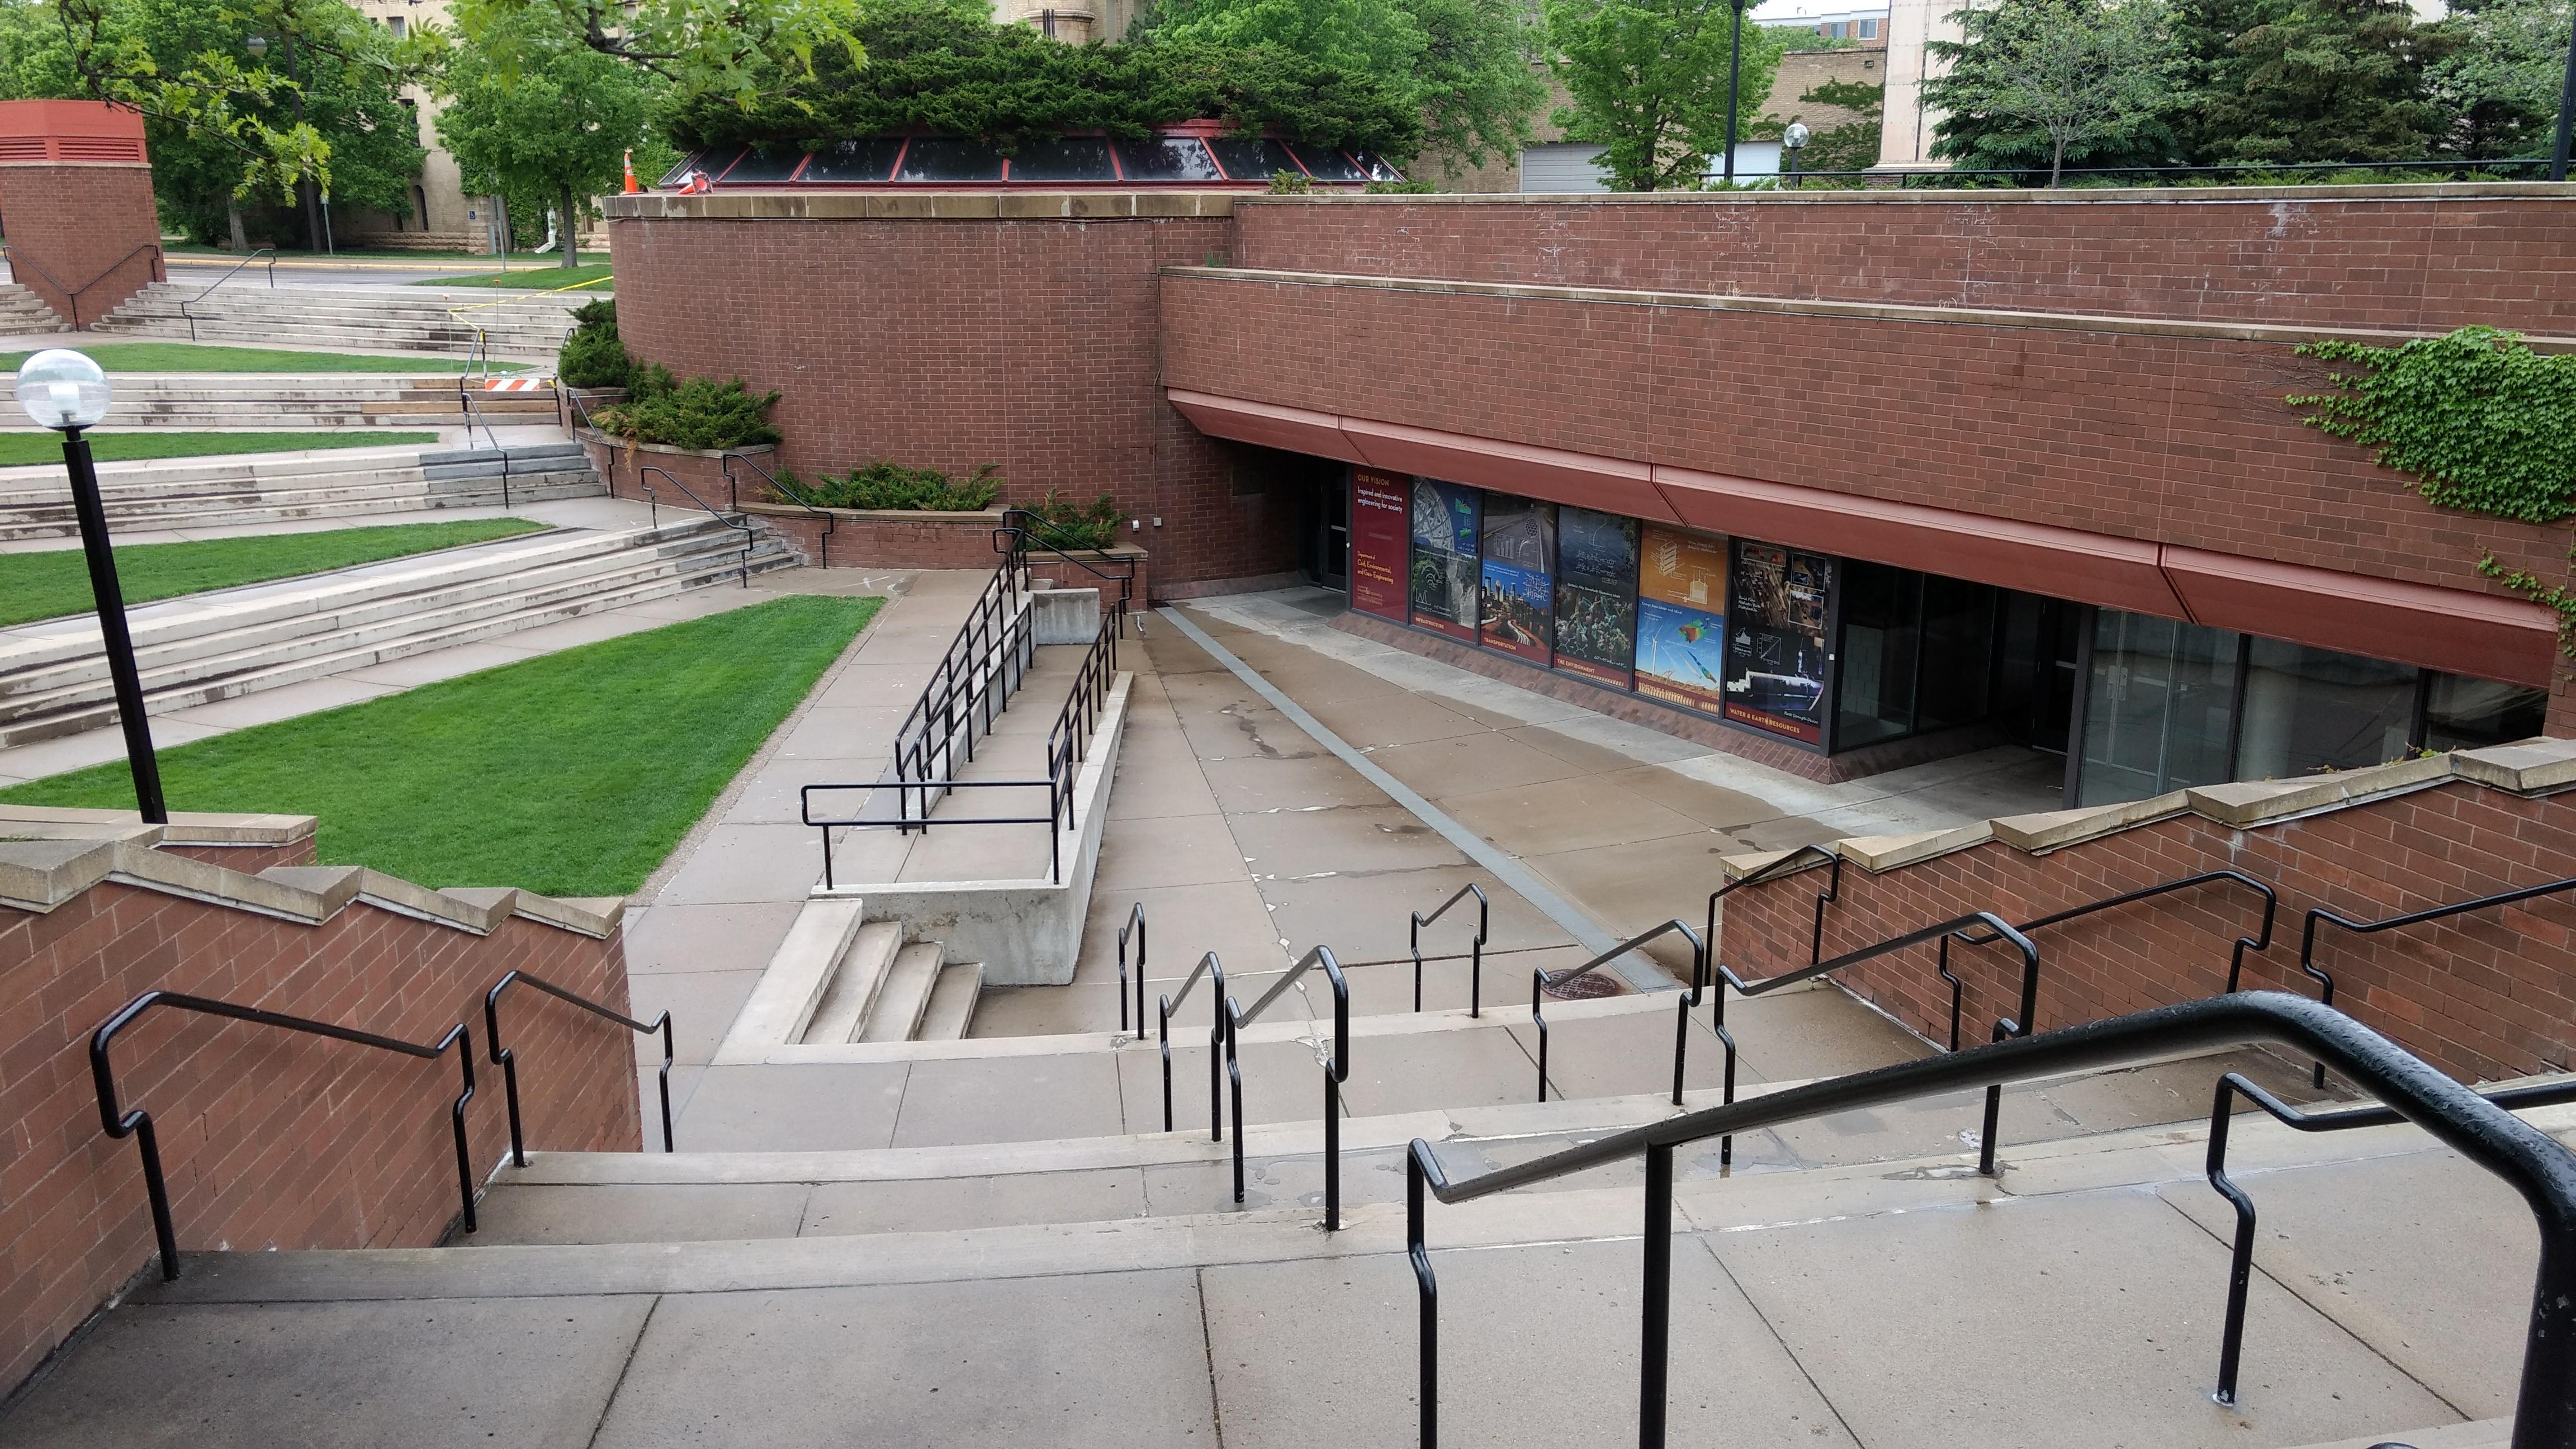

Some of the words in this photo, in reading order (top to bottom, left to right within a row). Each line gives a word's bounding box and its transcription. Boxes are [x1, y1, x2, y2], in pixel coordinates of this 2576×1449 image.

[1358, 474, 1369, 483] OUR
[1371, 476, 1389, 486] VISION
[1357, 485, 1374, 496] Inspired
[1382, 492, 1403, 502] innovative
[1357, 498, 1381, 509] engineering
[1388, 505, 1403, 514] society
[1357, 551, 1372, 559] Department
[1373, 571, 1394, 585] Engineering
[1415, 617, 1445, 629] INFRASTRUCTURE
[1484, 637, 1517, 650] TRANSPORTATION
[1565, 661, 1595, 674] ENVIRONMENT
[1639, 682, 1665, 693] RENEWABLE
[1665, 690, 1683, 699] ENERGY
[1730, 708, 1746, 718] WATER
[1751, 714, 1768, 725] EARTH
[1769, 720, 1800, 734] RESOURCES
